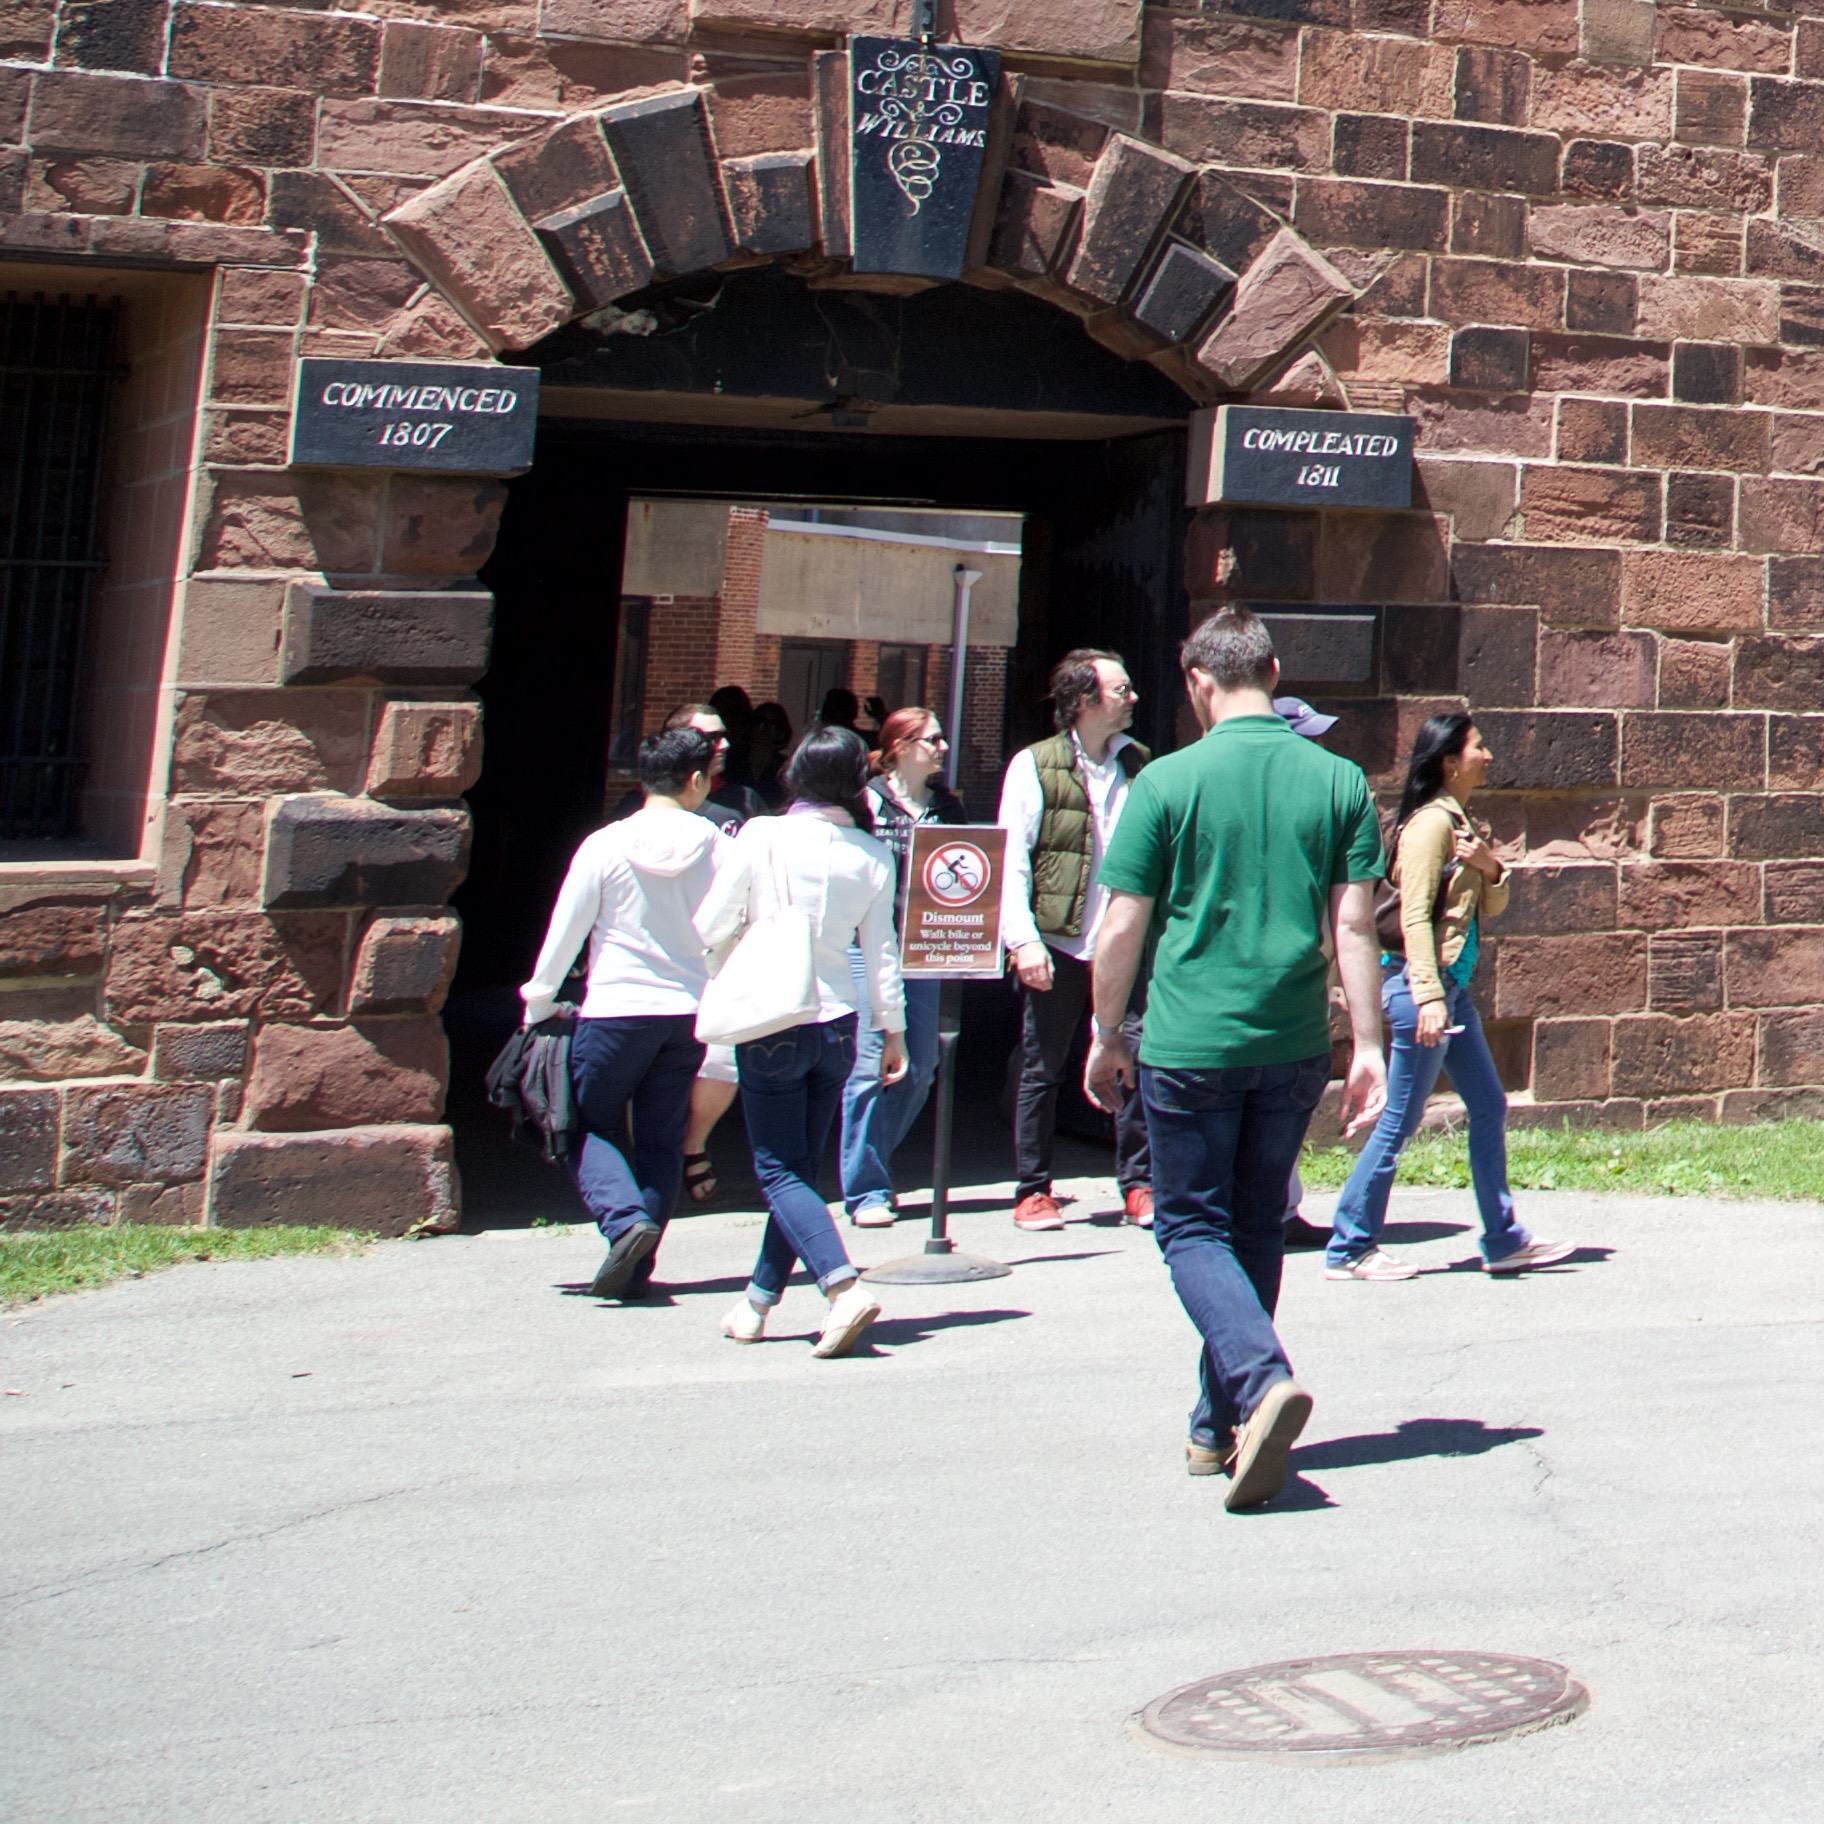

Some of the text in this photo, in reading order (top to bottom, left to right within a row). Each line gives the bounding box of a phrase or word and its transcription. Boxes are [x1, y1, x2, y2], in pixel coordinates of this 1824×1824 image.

[857, 69, 989, 107] CASTLE
[855, 112, 987, 148] WILLIAMS
[322, 382, 518, 414] COMMENCED
[378, 422, 453, 449] 1807
[1243, 428, 1399, 458] COMPLEATED
[1296, 464, 1341, 487] 1811
[922, 911, 985, 924] Dismount
[920, 929, 984, 939] Walk bike or
[909, 941, 992, 954] unicycle beyond
[925, 952, 974, 965] this point
